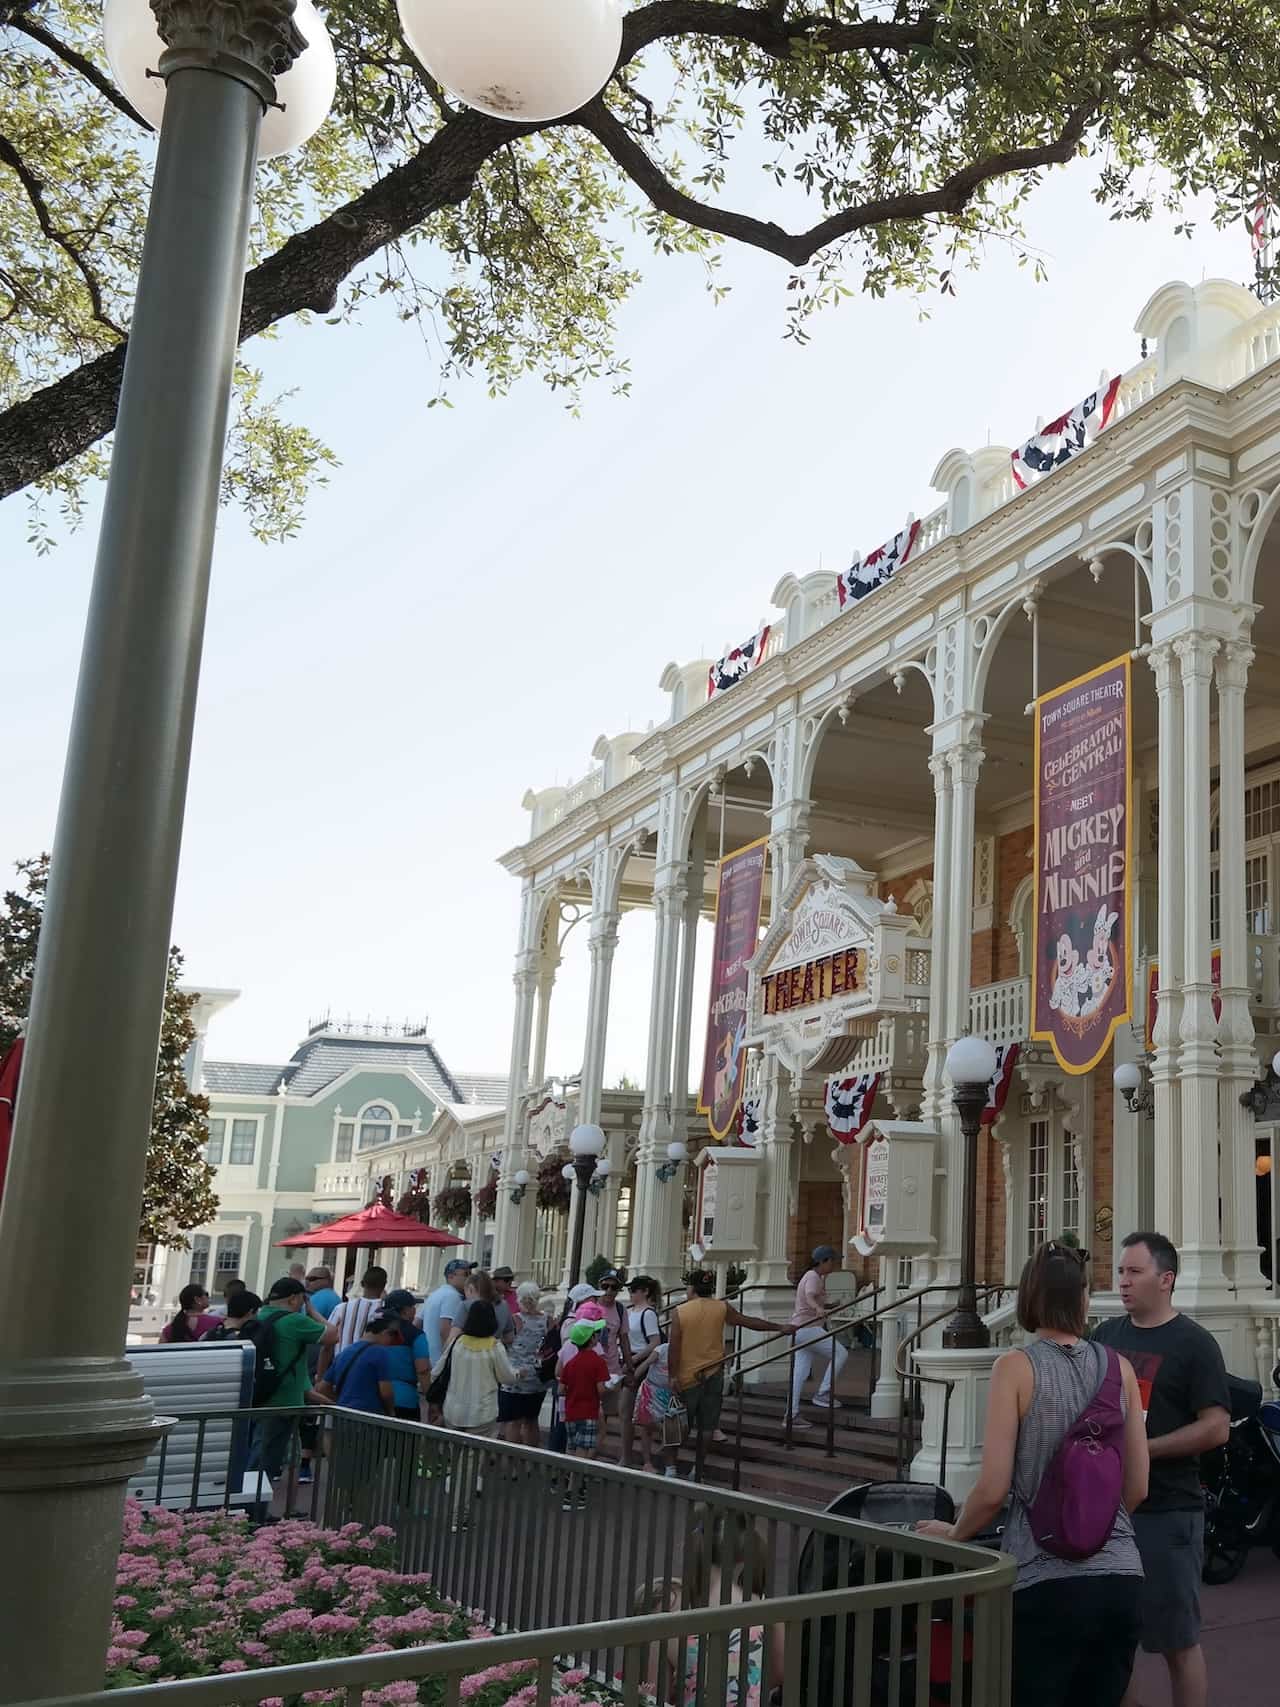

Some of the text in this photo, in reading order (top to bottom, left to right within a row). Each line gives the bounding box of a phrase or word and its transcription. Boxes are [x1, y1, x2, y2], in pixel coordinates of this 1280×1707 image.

[1042, 706, 1062, 733] TOWN
[1062, 692, 1090, 716] SQUARE
[1090, 680, 1124, 702] THEATER
[1044, 713, 1122, 781] CELEBRATION
[1062, 735, 1122, 787] CENTRAL
[1070, 792, 1094, 811] MEET
[1043, 803, 1125, 871] MICKEY
[1074, 847, 1091, 871] and
[1042, 850, 1125, 914] MINNIE
[790, 911, 845, 954] TOWN SQUARE
[761, 947, 859, 1015] THEATER
